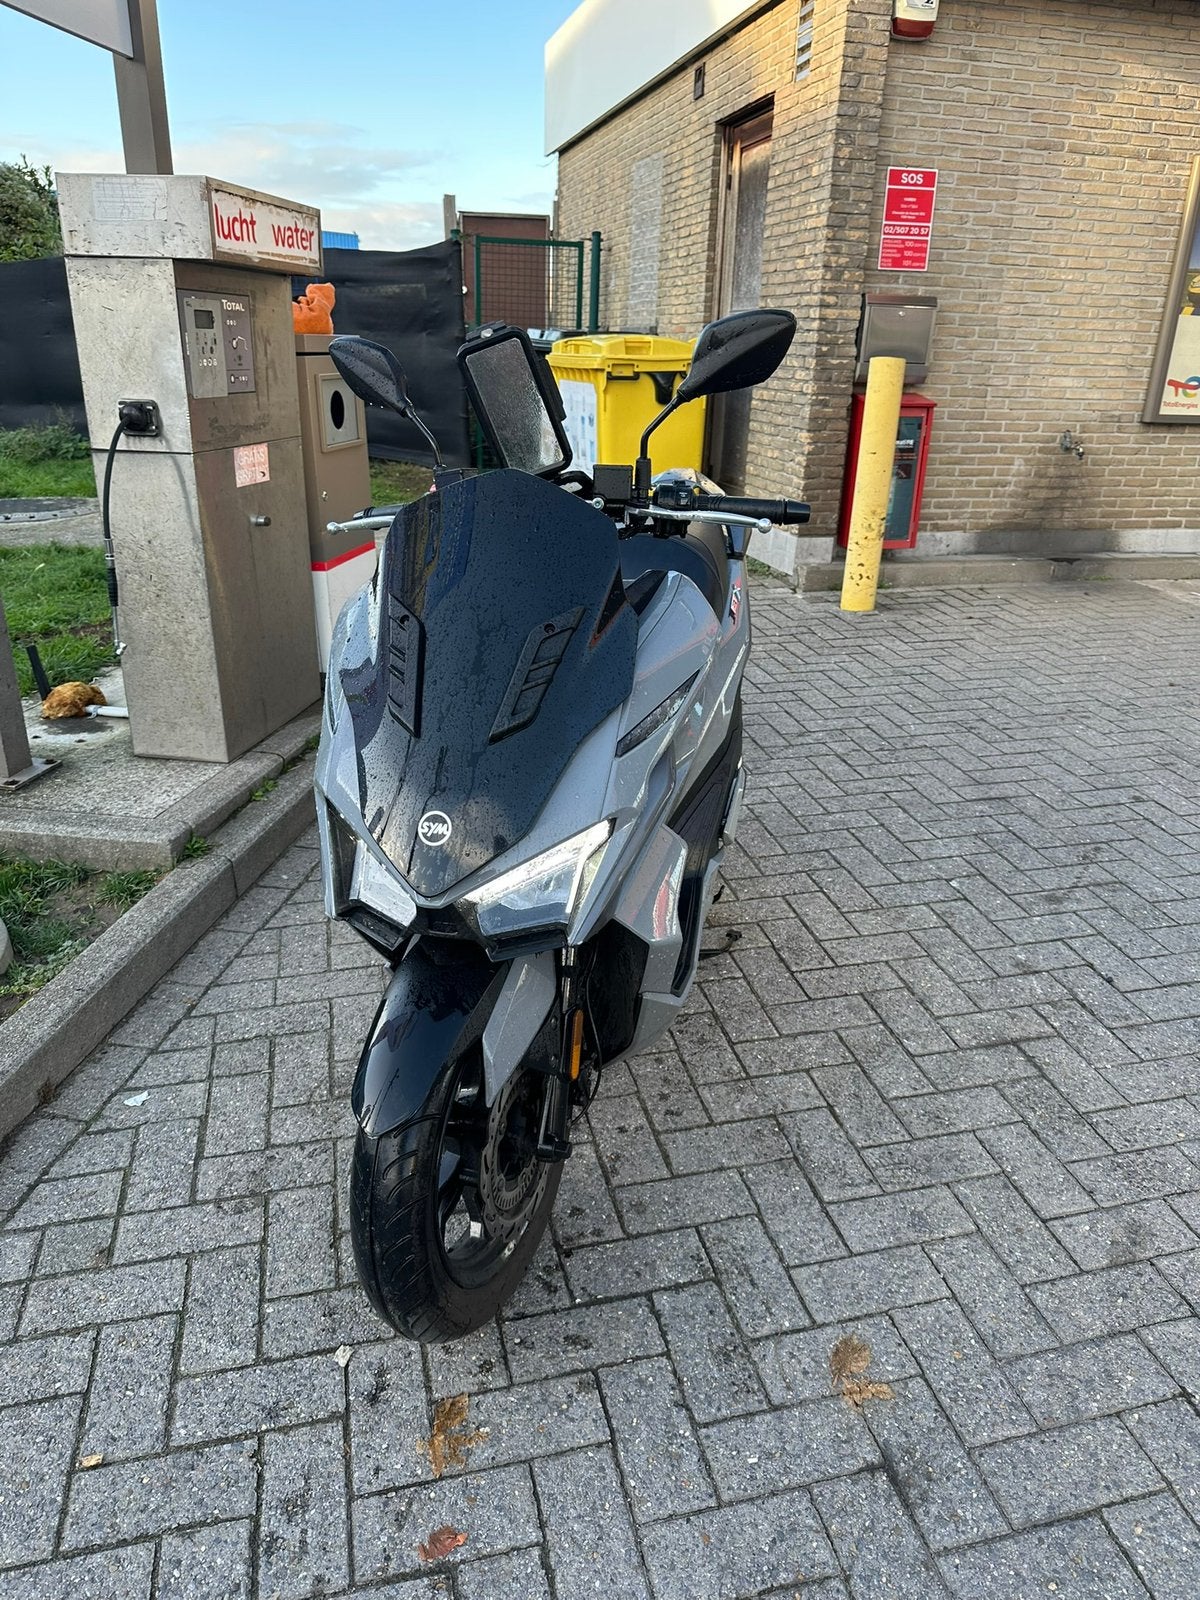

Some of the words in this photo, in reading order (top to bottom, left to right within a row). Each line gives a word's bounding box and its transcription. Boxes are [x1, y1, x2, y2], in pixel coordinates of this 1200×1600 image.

[901, 173, 924, 184] SOS
[214, 203, 257, 244] lucht
[271, 220, 315, 251] water
[884, 226, 909, 235] 02/507
[909, 227, 919, 235] 20
[920, 227, 929, 235] 57
[221, 299, 245, 312] TOTAL
[420, 821, 449, 837] SYM
